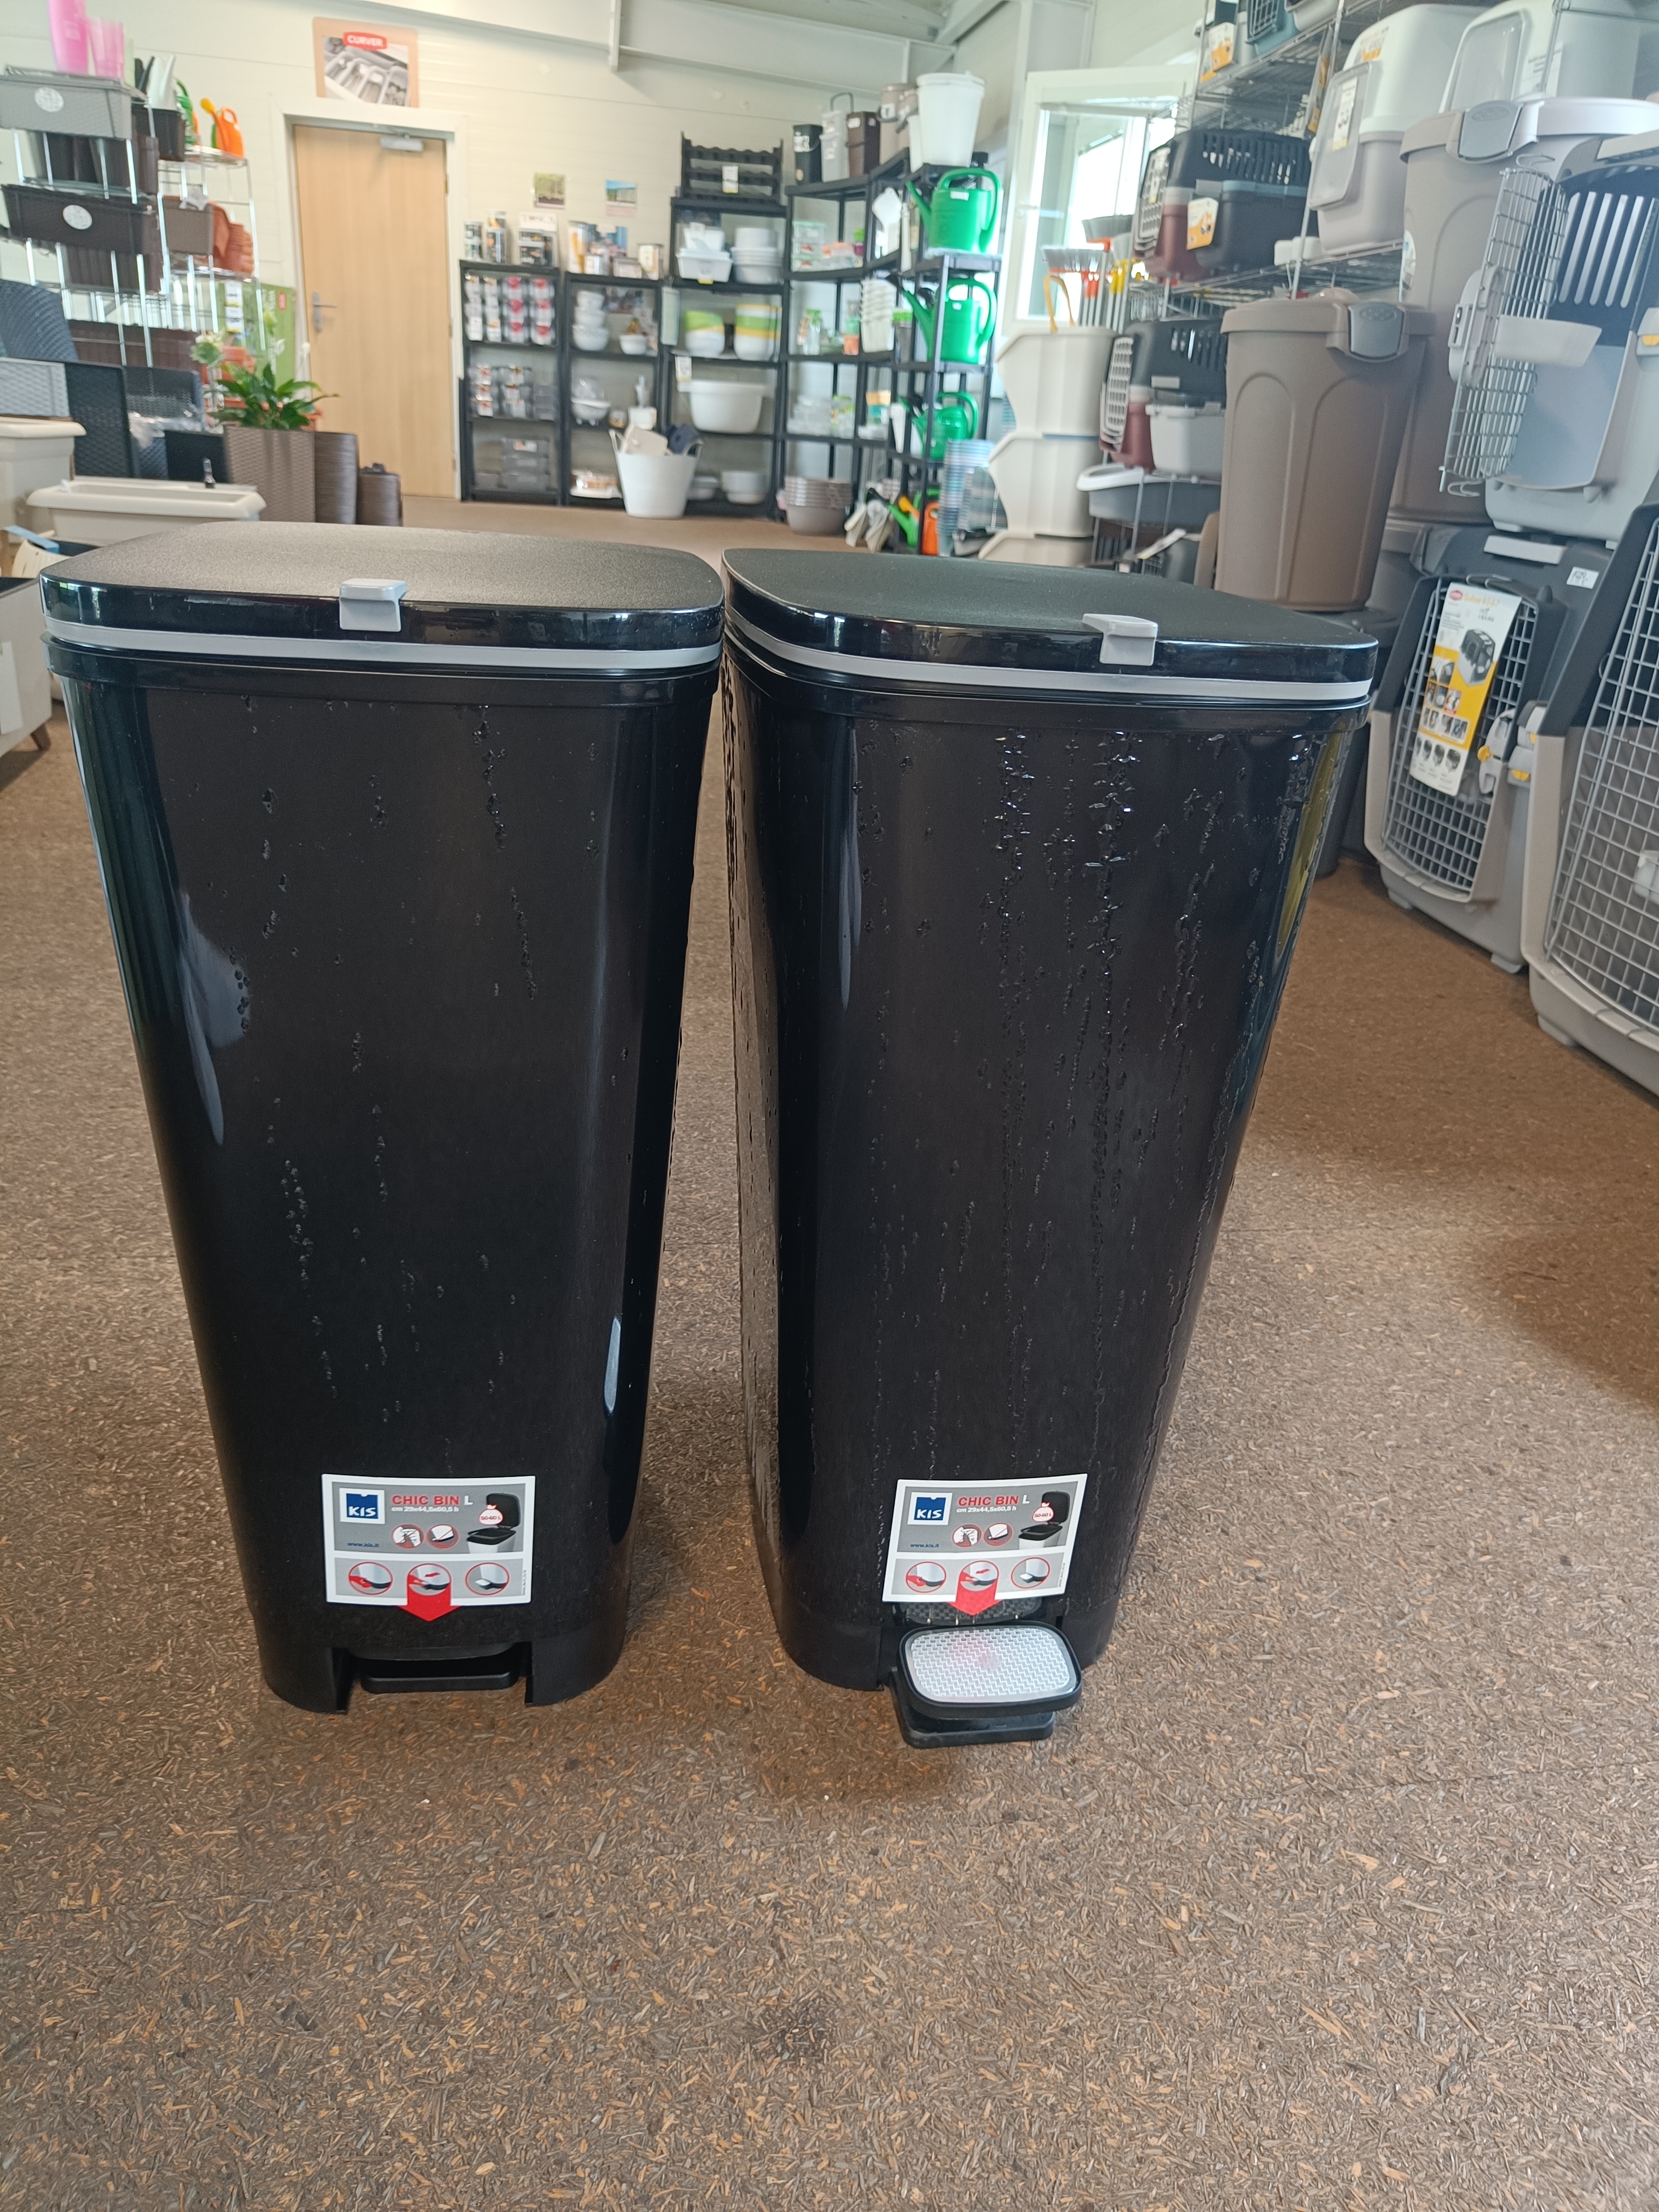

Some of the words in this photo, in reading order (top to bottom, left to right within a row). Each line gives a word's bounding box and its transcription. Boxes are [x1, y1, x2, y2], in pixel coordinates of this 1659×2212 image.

[392, 1495, 429, 1505] CHIC
[434, 1495, 460, 1506] BIN
[464, 1495, 474, 1506] L
[958, 1496, 992, 1506] CHIC
[995, 1495, 1020, 1506] BIN
[1022, 1495, 1030, 1504] L
[348, 1506, 376, 1517] KIS
[916, 1509, 942, 1519] KIS
